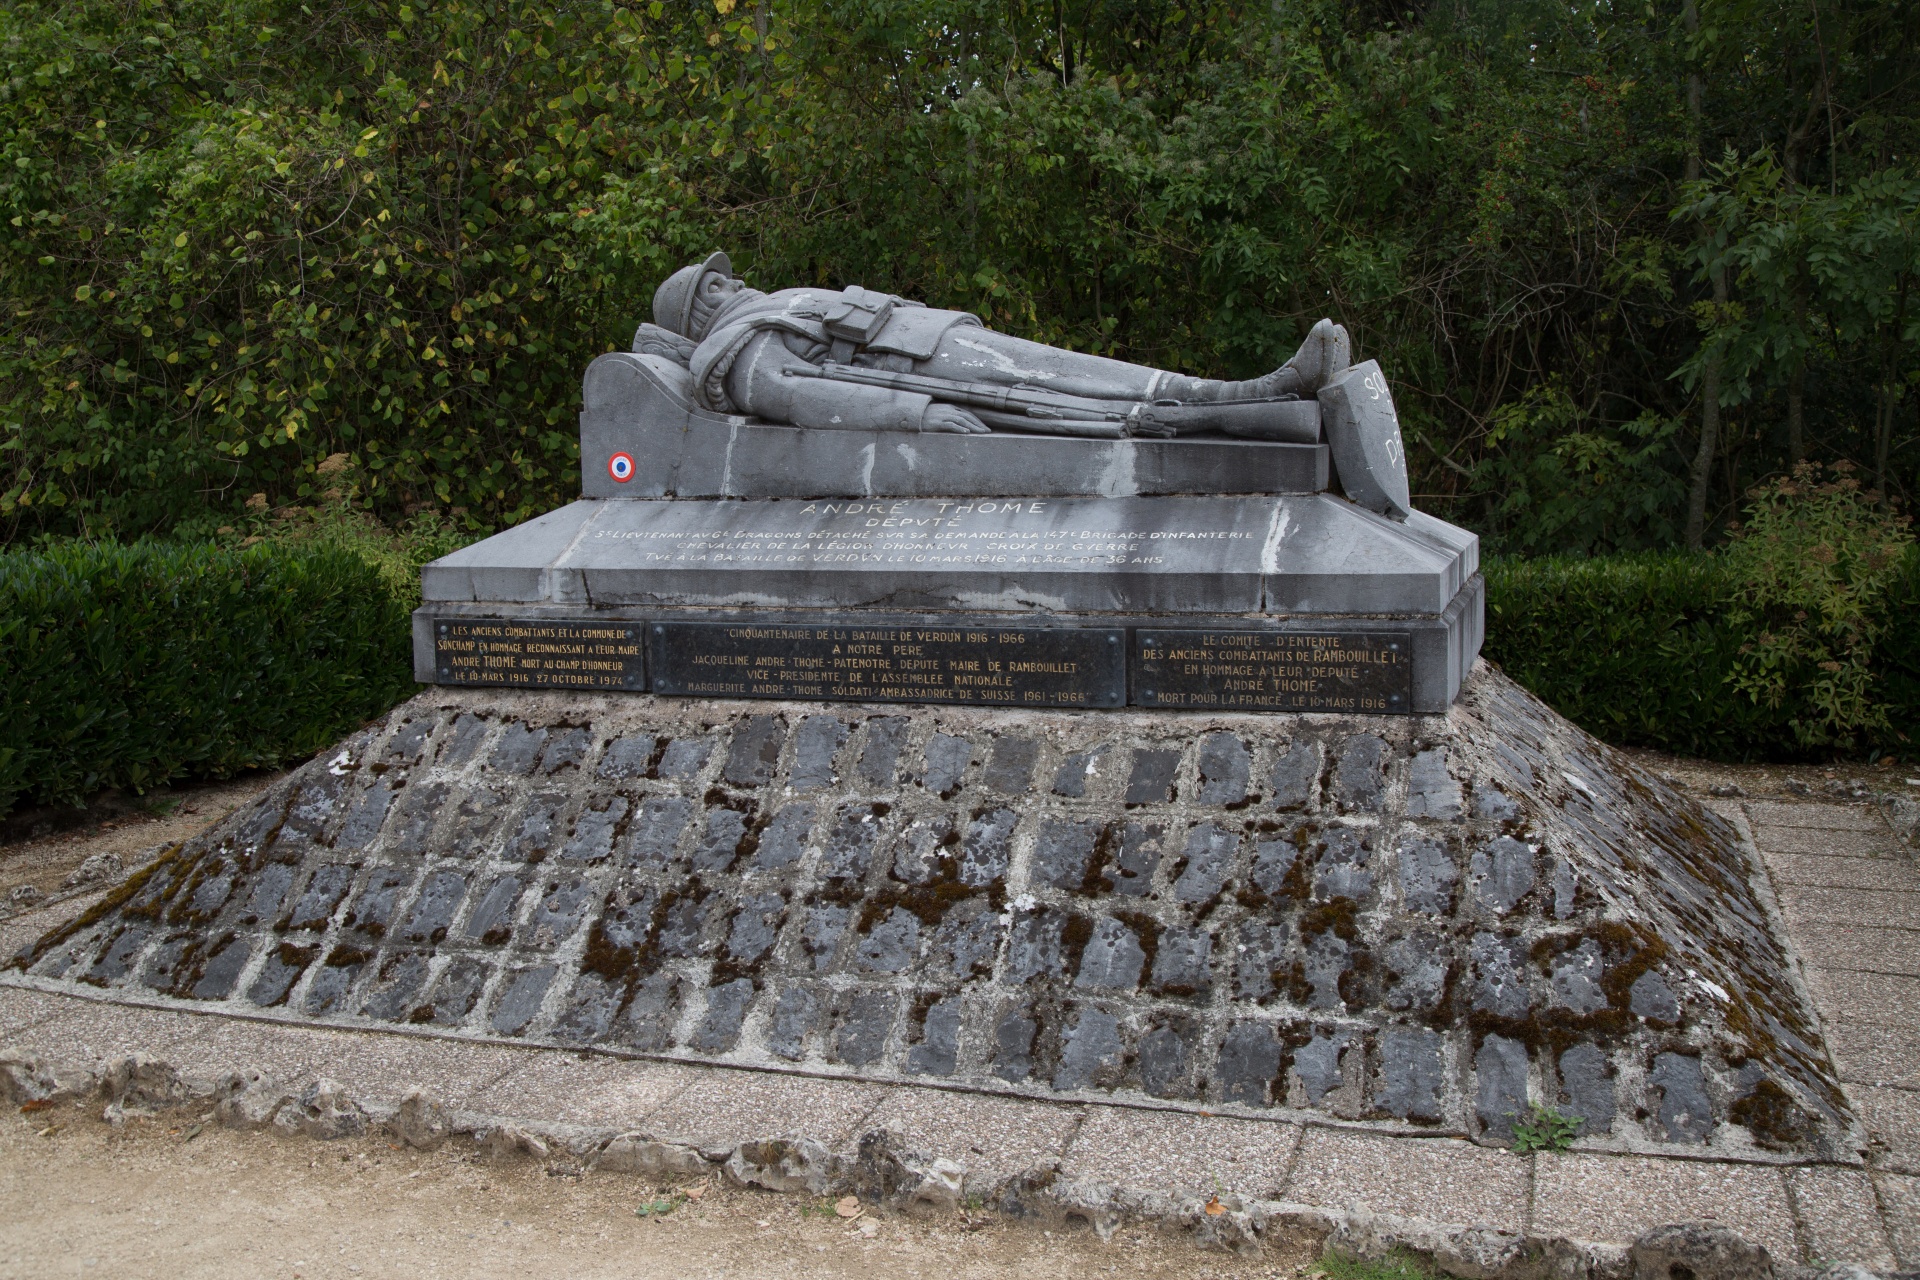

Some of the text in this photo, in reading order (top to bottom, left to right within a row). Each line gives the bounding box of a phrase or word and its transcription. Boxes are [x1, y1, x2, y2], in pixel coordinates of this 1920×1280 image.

[800, 501, 1047, 514] ANDRÉ THOME
[734, 531, 802, 539] DRAGONS
[1080, 530, 1146, 539] BRIGADE
[818, 540, 873, 550] LÉGION
[986, 542, 1038, 550] CROIX
[974, 553, 1007, 562] 1916
[1106, 555, 1126, 563] 36
[453, 626, 627, 639] LES ANCIENS COMBATTANTS ET LA COMMUNE DE
[816, 630, 829, 640] DE
[834, 631, 847, 641] LA
[852, 631, 896, 642] BATAILLE
[900, 632, 913, 642] DE
[916, 632, 961, 643] VERDUN
[966, 633, 988, 643] 1916
[999, 633, 1025, 644] 1966
[438, 640, 476, 651] SONCHAMP
[479, 643, 488, 652] EN
[490, 644, 523, 653] HOMMAGE
[526, 643, 586, 655] RECONNAISSANT
[596, 645, 616, 655] LEUR
[618, 645, 640, 656] MAIRE
[1203, 635, 1340, 648] LE COMITE D'ENTENTE
[833, 644, 923, 656] A NOTRE PERE
[1143, 649, 1397, 664] DES ANCIENS COMBATTANTS DE RAMBOUILLET
[483, 655, 517, 668] THOME
[521, 659, 541, 668] MORT
[543, 660, 555, 669] AU
[556, 660, 580, 670] CHAMP
[692, 656, 750, 667] JACQUELINE
[755, 657, 786, 668] ANDRE
[793, 657, 824, 669] THOME
[834, 658, 892, 670] PATENOTRE
[900, 660, 940, 670] DEPUTE
[949, 660, 981, 671] MAIRE
[988, 661, 1001, 672] DE
[1009, 661, 1077, 673] RAMBOUILLET
[1184, 664, 1198, 675] EN
[1203, 664, 1254, 676] HOMMAGE
[1272, 666, 1303, 678] LEUR
[455, 671, 624, 686] LE 10 MARS 1916 27 OCTOBRE 1974
[747, 670, 769, 680] VICE
[780, 671, 840, 682] PRESIDENTE
[849, 672, 862, 683] DE
[872, 673, 944, 685] L'ASSEMBLEE
[954, 675, 1013, 687] NATIONALE
[687, 682, 746, 693] MARGUERITE
[751, 684, 785, 694] ANDRE
[793, 685, 823, 695] THOME
[832, 687, 872, 697] SOLDATI
[879, 687, 954, 699] AMBASSADRICE
[959, 689, 973, 699] DE
[981, 690, 1016, 701] SUISSE
[1024, 691, 1046, 701] 1961
[1273, 680, 1317, 692] THOME
[1157, 692, 1386, 709] MORT POUR LA FRANCE LE 10 MARS 1916
